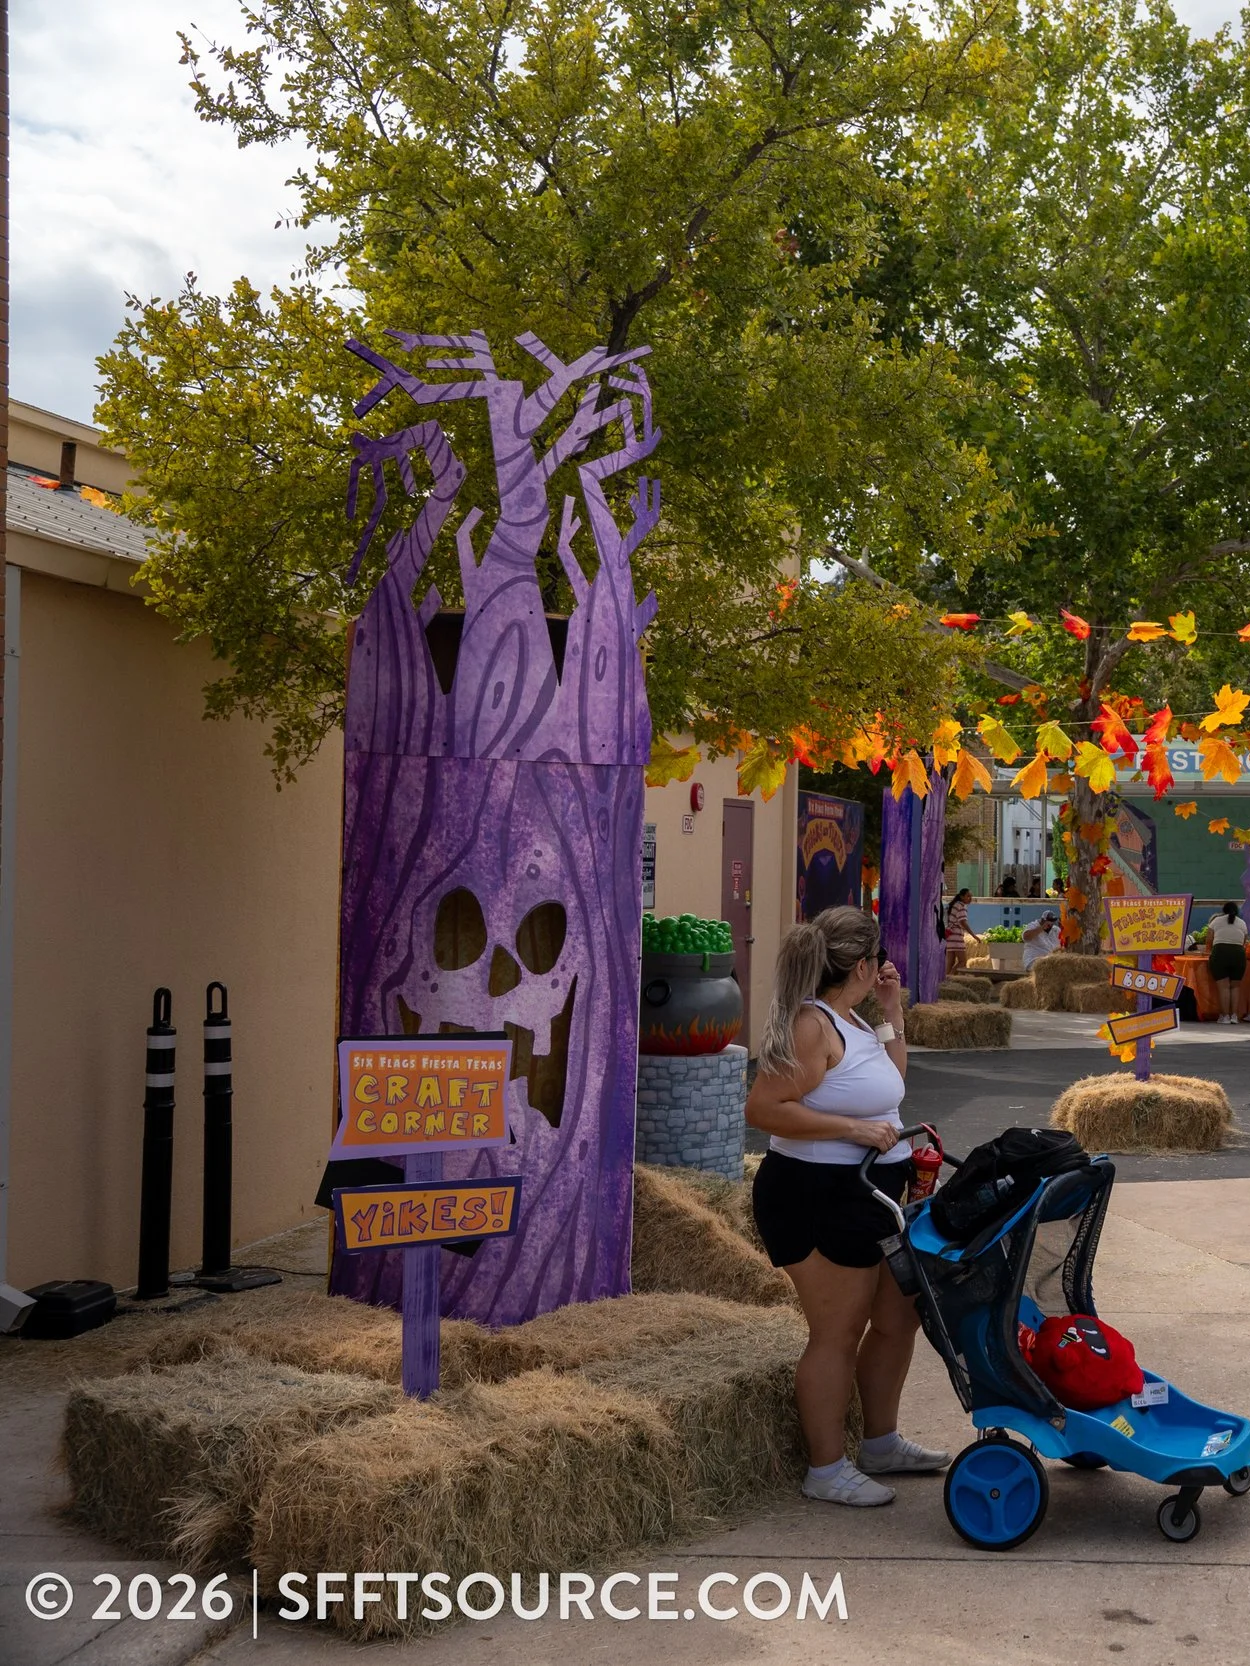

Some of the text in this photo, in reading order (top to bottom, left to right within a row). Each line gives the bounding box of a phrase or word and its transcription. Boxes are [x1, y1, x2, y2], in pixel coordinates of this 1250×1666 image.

[1132, 929, 1179, 946] TREATS
[1122, 970, 1169, 993] BOO!
[353, 1056, 503, 1071] SIX FLAGS FIESTA TEXAS
[353, 1073, 499, 1109] CRAFT
[356, 1108, 490, 1137] CORNER
